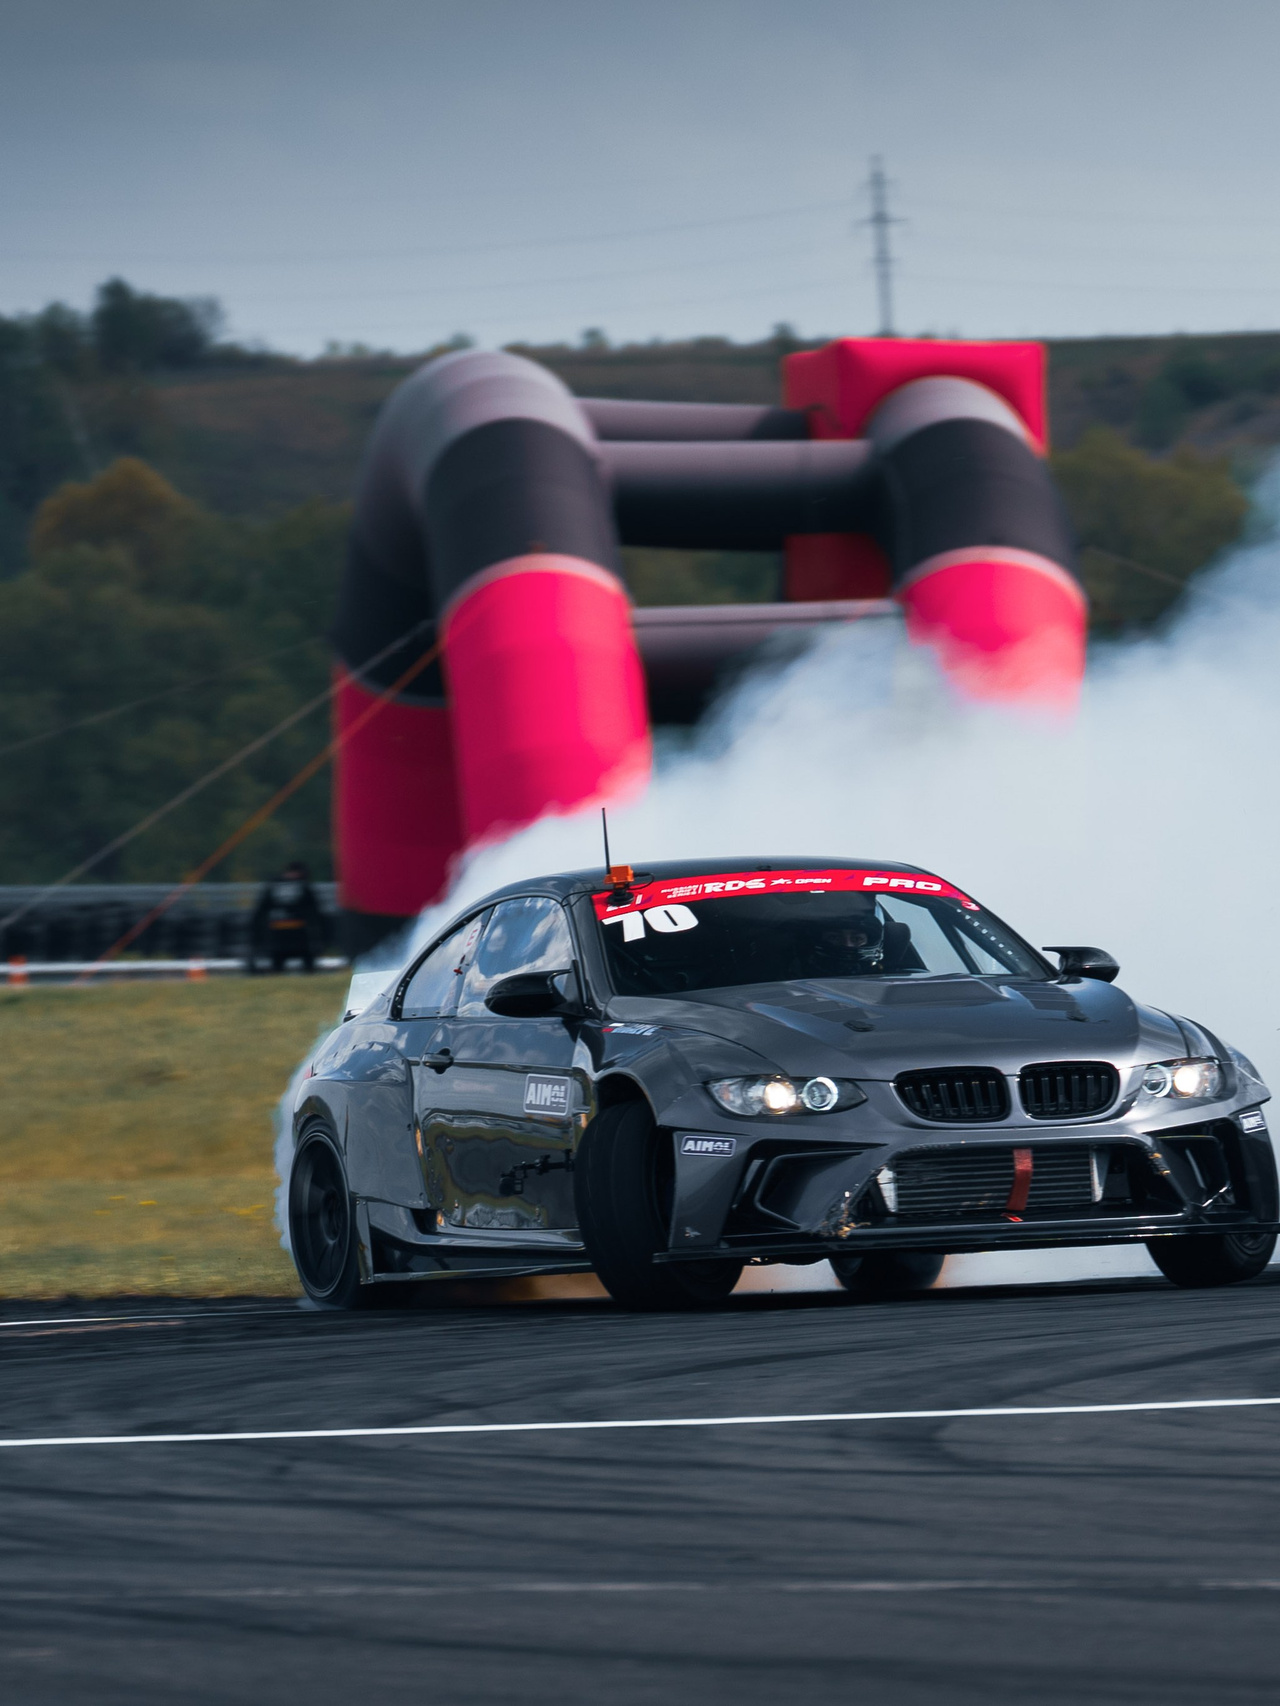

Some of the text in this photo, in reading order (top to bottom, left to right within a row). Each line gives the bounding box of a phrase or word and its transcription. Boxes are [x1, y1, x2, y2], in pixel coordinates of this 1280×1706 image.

[704, 878, 766, 893] RDS
[862, 876, 942, 891] PRO
[601, 904, 699, 943] 70
